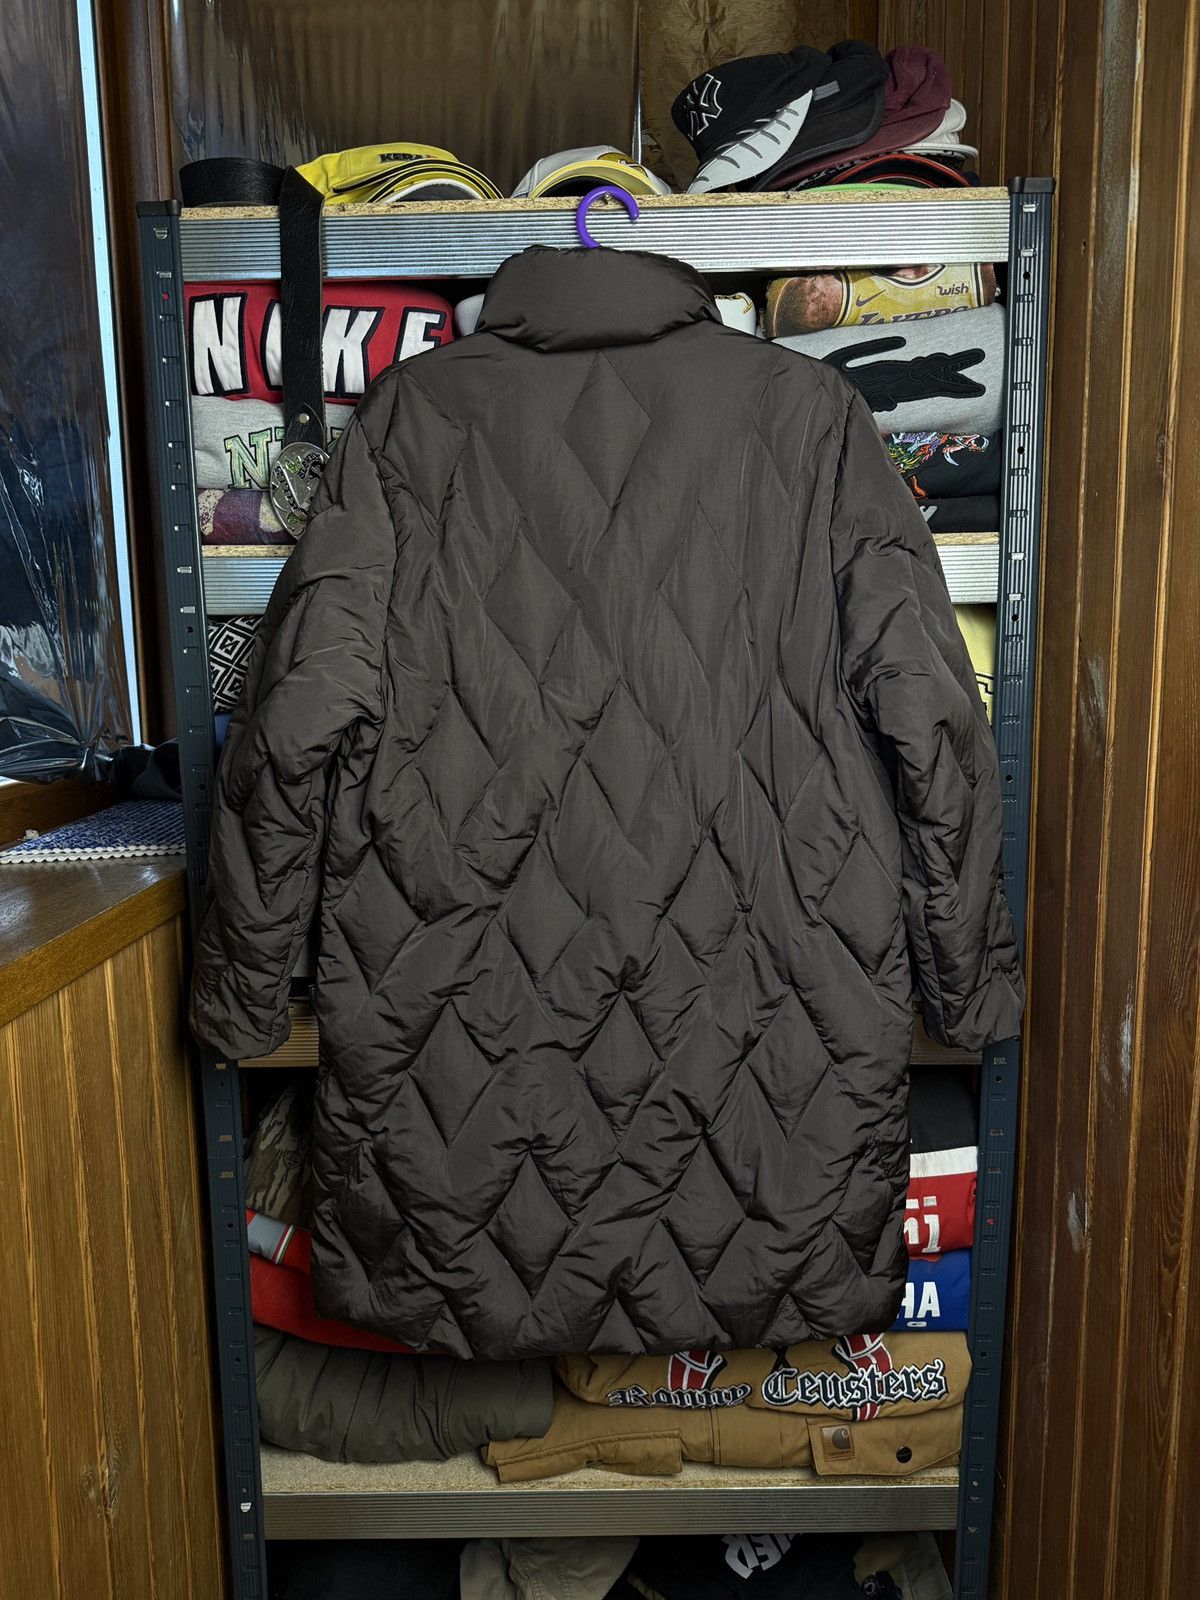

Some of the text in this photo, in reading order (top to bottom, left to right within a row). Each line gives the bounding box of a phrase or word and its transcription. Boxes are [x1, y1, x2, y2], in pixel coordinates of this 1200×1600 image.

[936, 282, 969, 296] wish
[607, 1358, 946, 1410] Ronny Ceusters
